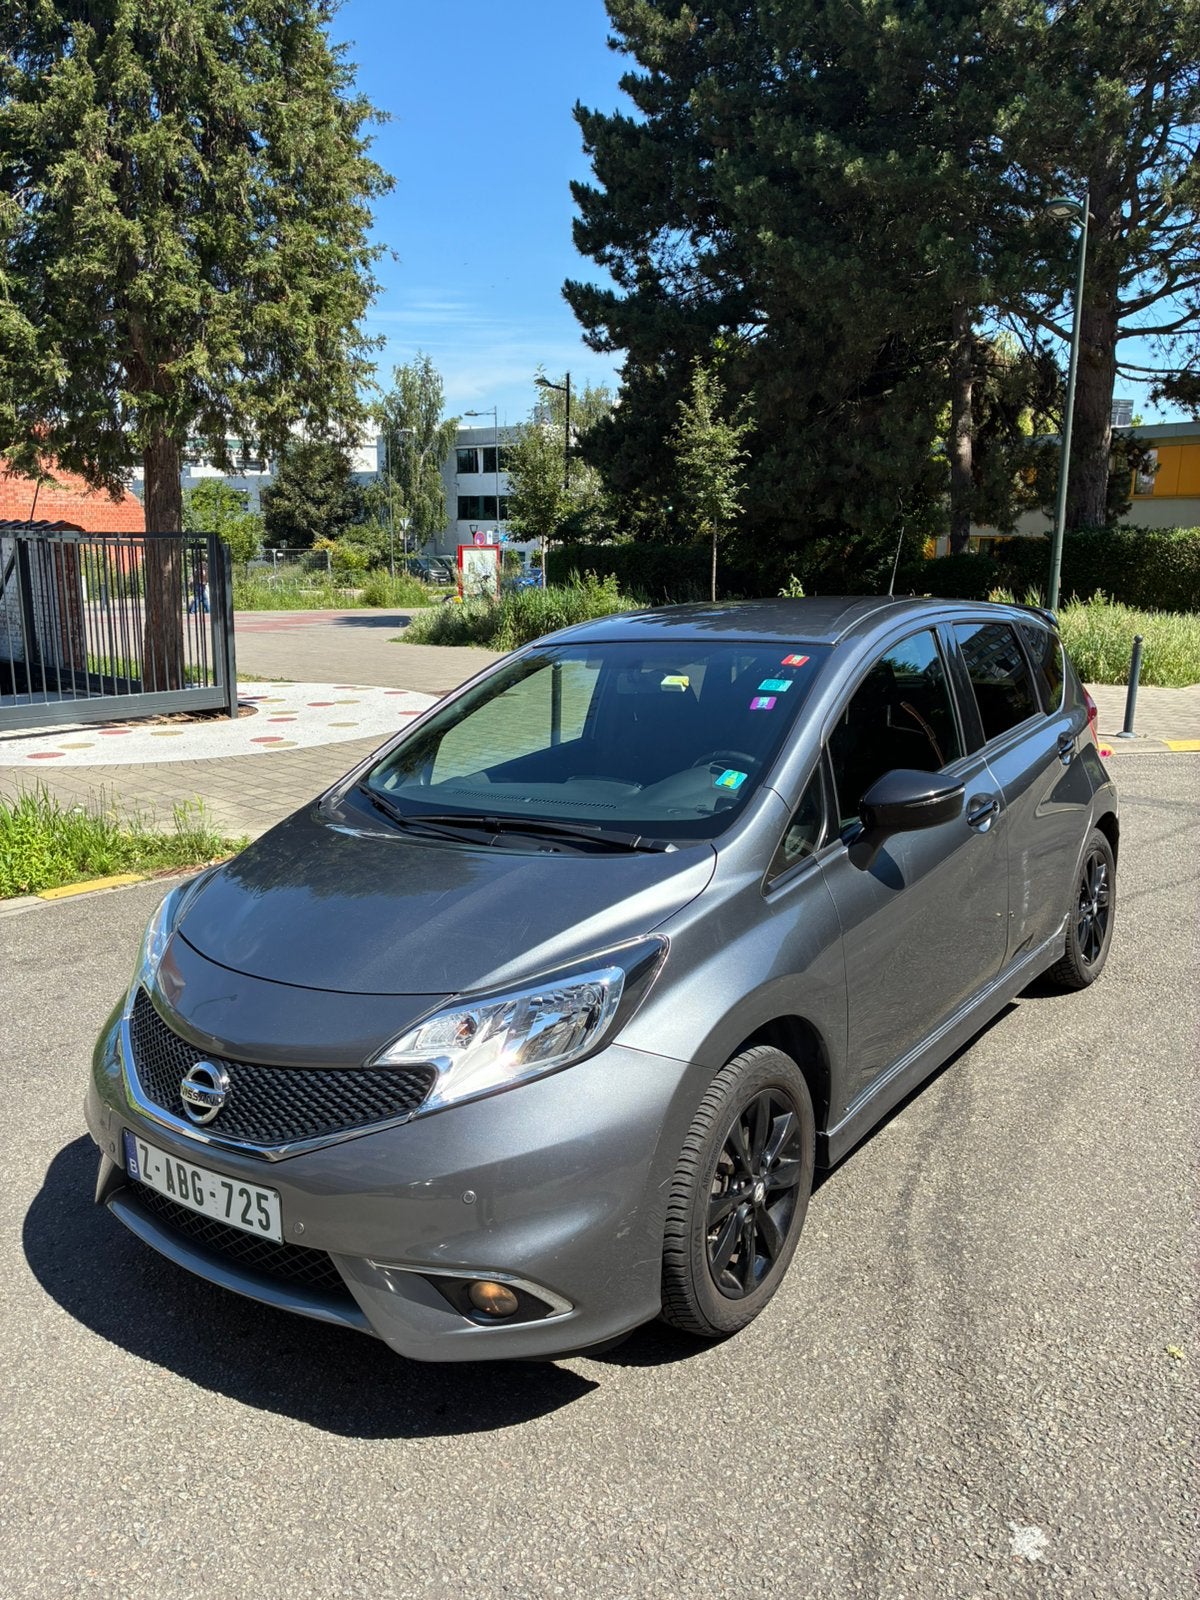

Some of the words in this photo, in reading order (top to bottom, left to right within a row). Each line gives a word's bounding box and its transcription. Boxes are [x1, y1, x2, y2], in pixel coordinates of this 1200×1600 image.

[181, 1085, 217, 1106] NISSAN
[129, 1158, 138, 1174] B
[139, 1143, 271, 1232] Z-ABG-725
[693, 1226, 707, 1298] NIROYAL
